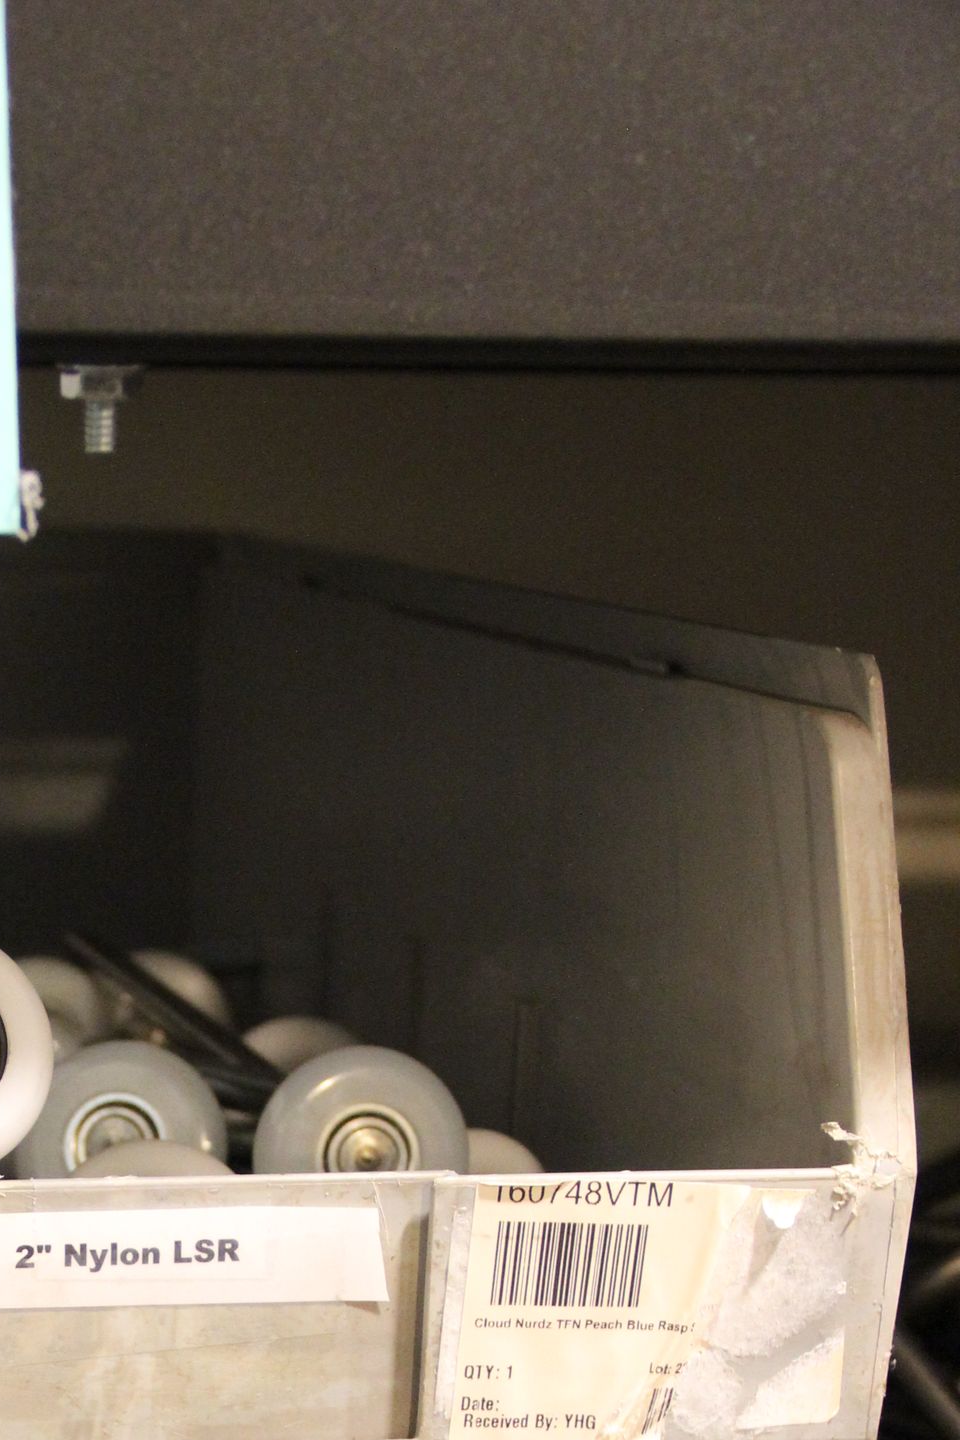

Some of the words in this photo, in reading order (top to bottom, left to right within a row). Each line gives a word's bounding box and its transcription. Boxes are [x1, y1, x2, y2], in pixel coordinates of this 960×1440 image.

[15, 1244, 52, 1269] 2"
[64, 1242, 160, 1272] Nylon
[174, 1239, 240, 1264] LSR
[474, 1318, 511, 1329] Cloud
[515, 1318, 552, 1329] Nurdz
[557, 1319, 581, 1329] TFN
[584, 1319, 622, 1330] Peach
[627, 1320, 654, 1331] Blue
[658, 1320, 688, 1333] Rasp
[464, 1365, 500, 1380] QTY:
[506, 1365, 513, 1380] 1
[649, 1362, 672, 1375] Lot:
[460, 1396, 500, 1411] Date:
[464, 1414, 528, 1429] Received
[535, 1414, 558, 1431] By:
[565, 1415, 596, 1430] YHG
